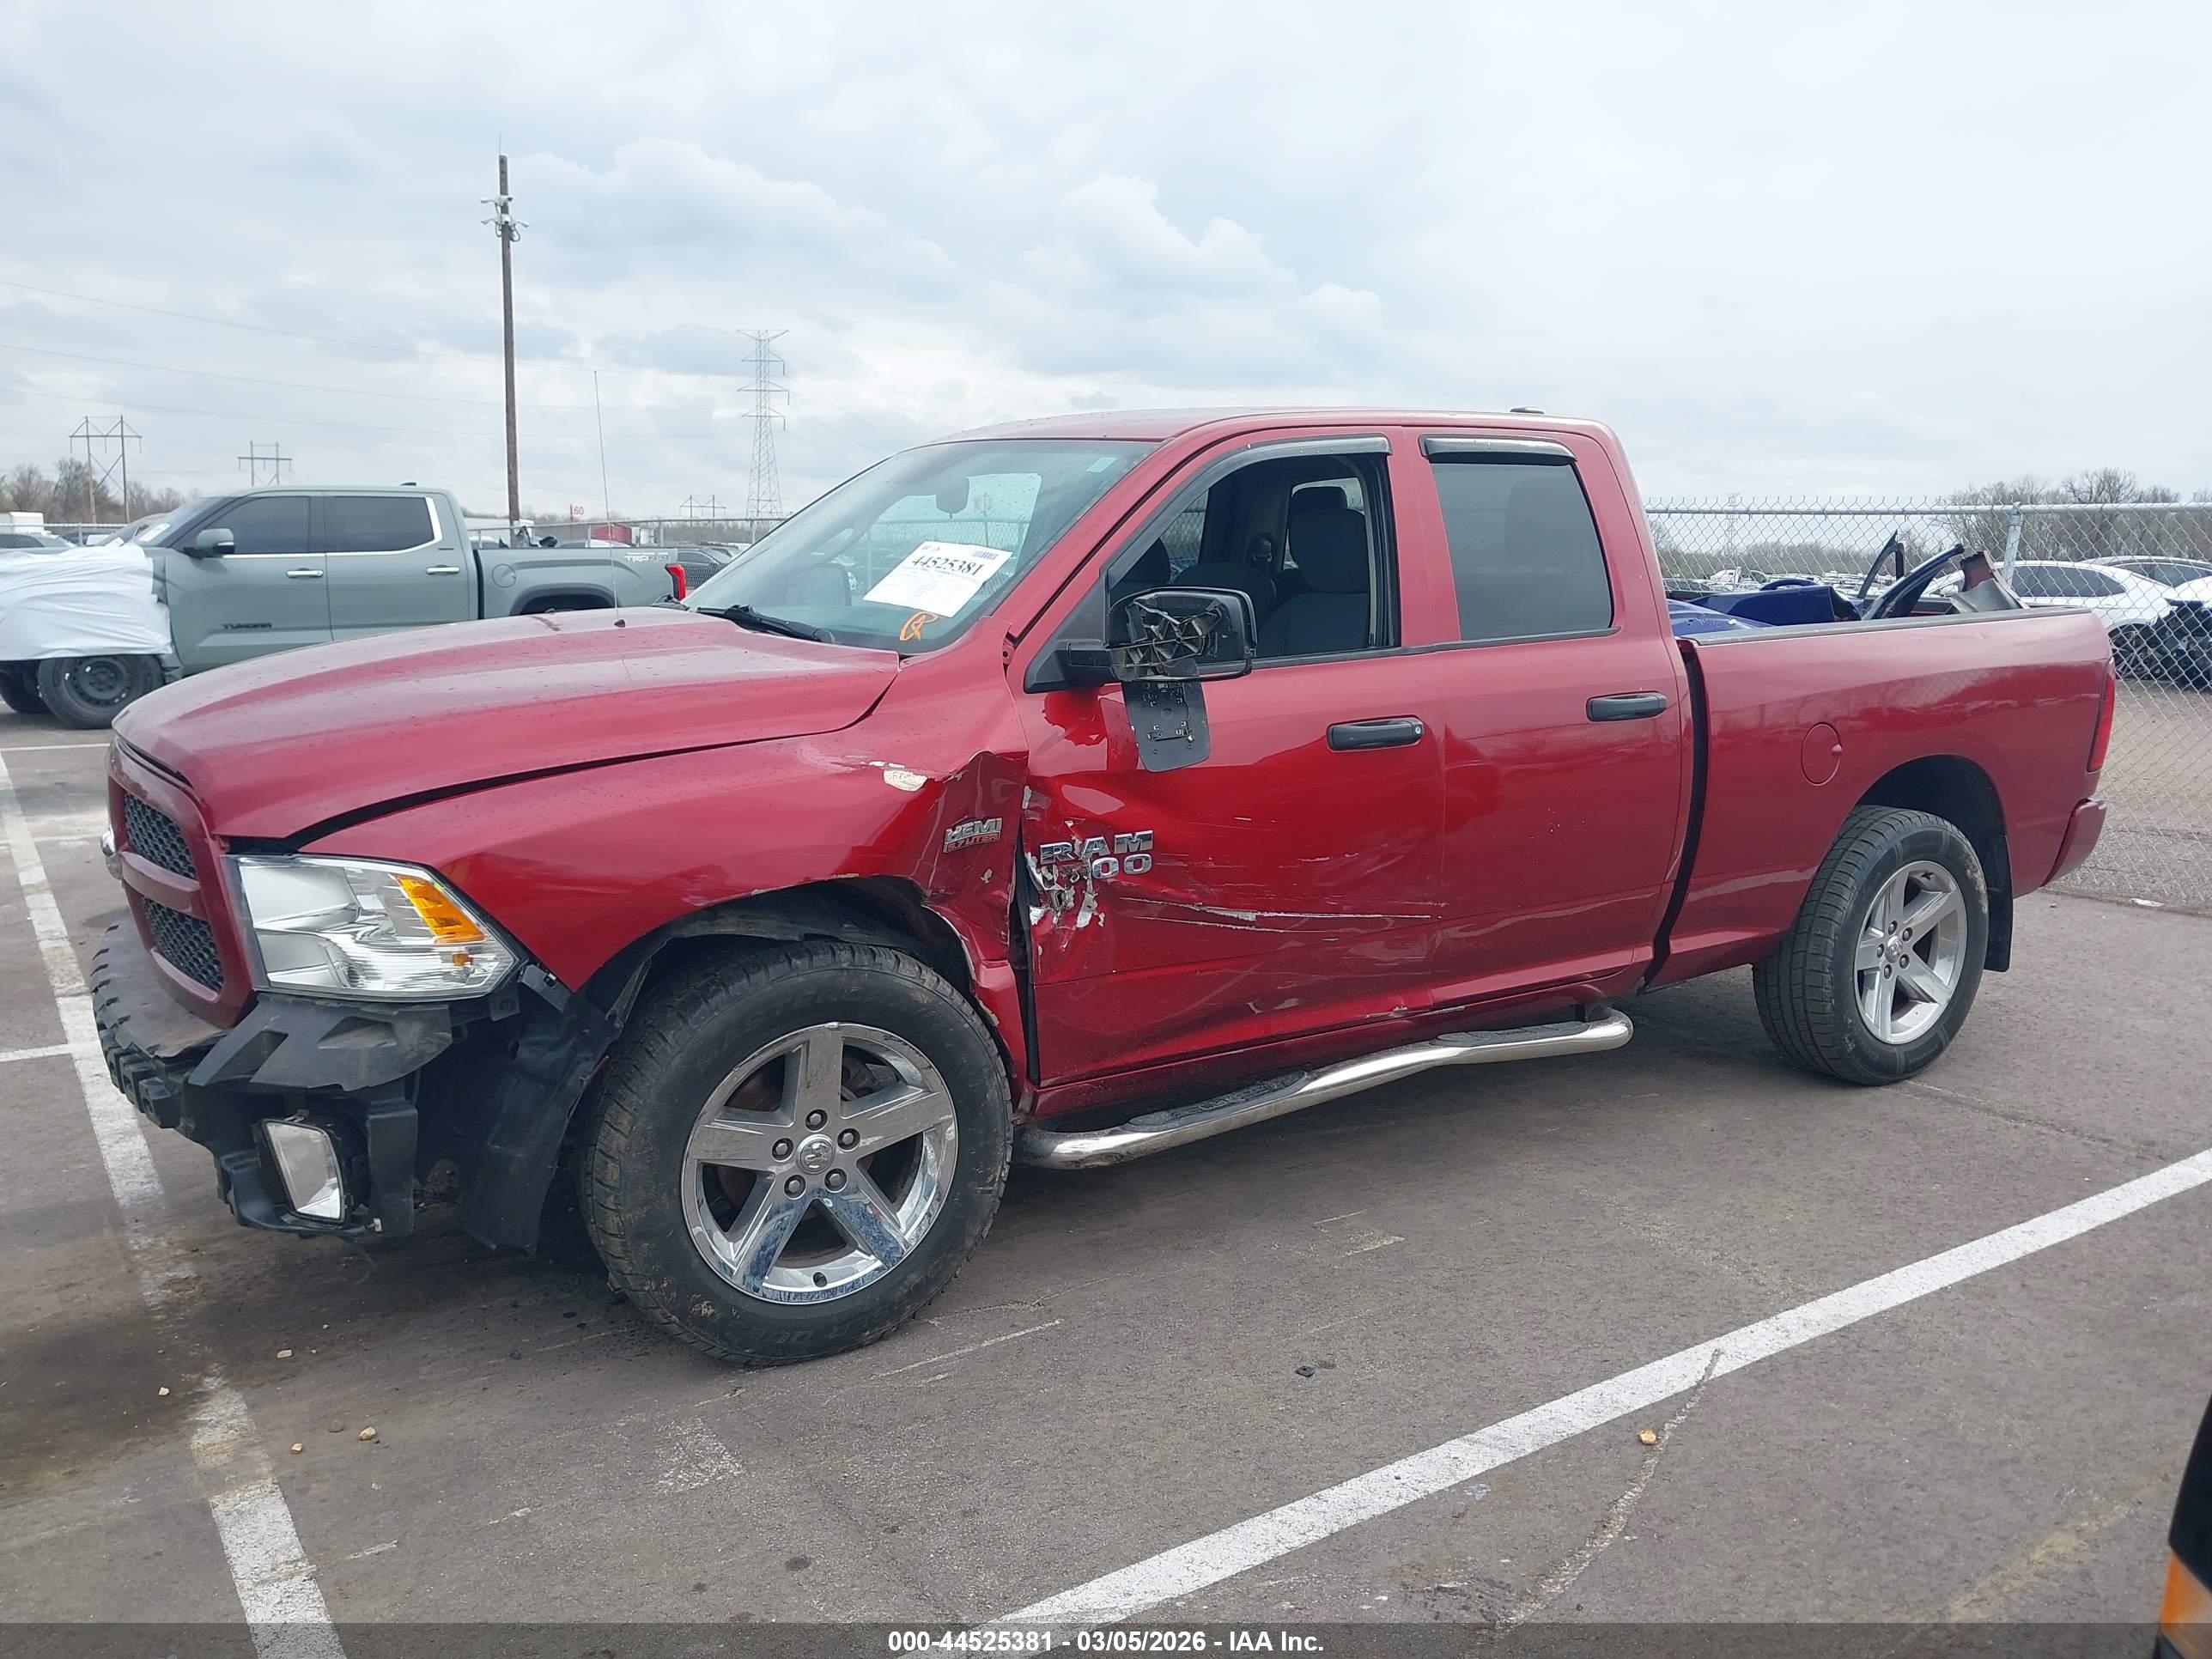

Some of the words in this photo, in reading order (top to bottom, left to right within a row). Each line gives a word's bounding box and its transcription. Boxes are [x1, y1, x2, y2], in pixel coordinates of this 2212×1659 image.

[912, 556, 984, 575] 44525381
[945, 817, 1002, 842] HEMI
[966, 831, 999, 846] LITER
[1040, 830, 1153, 865] RAM
